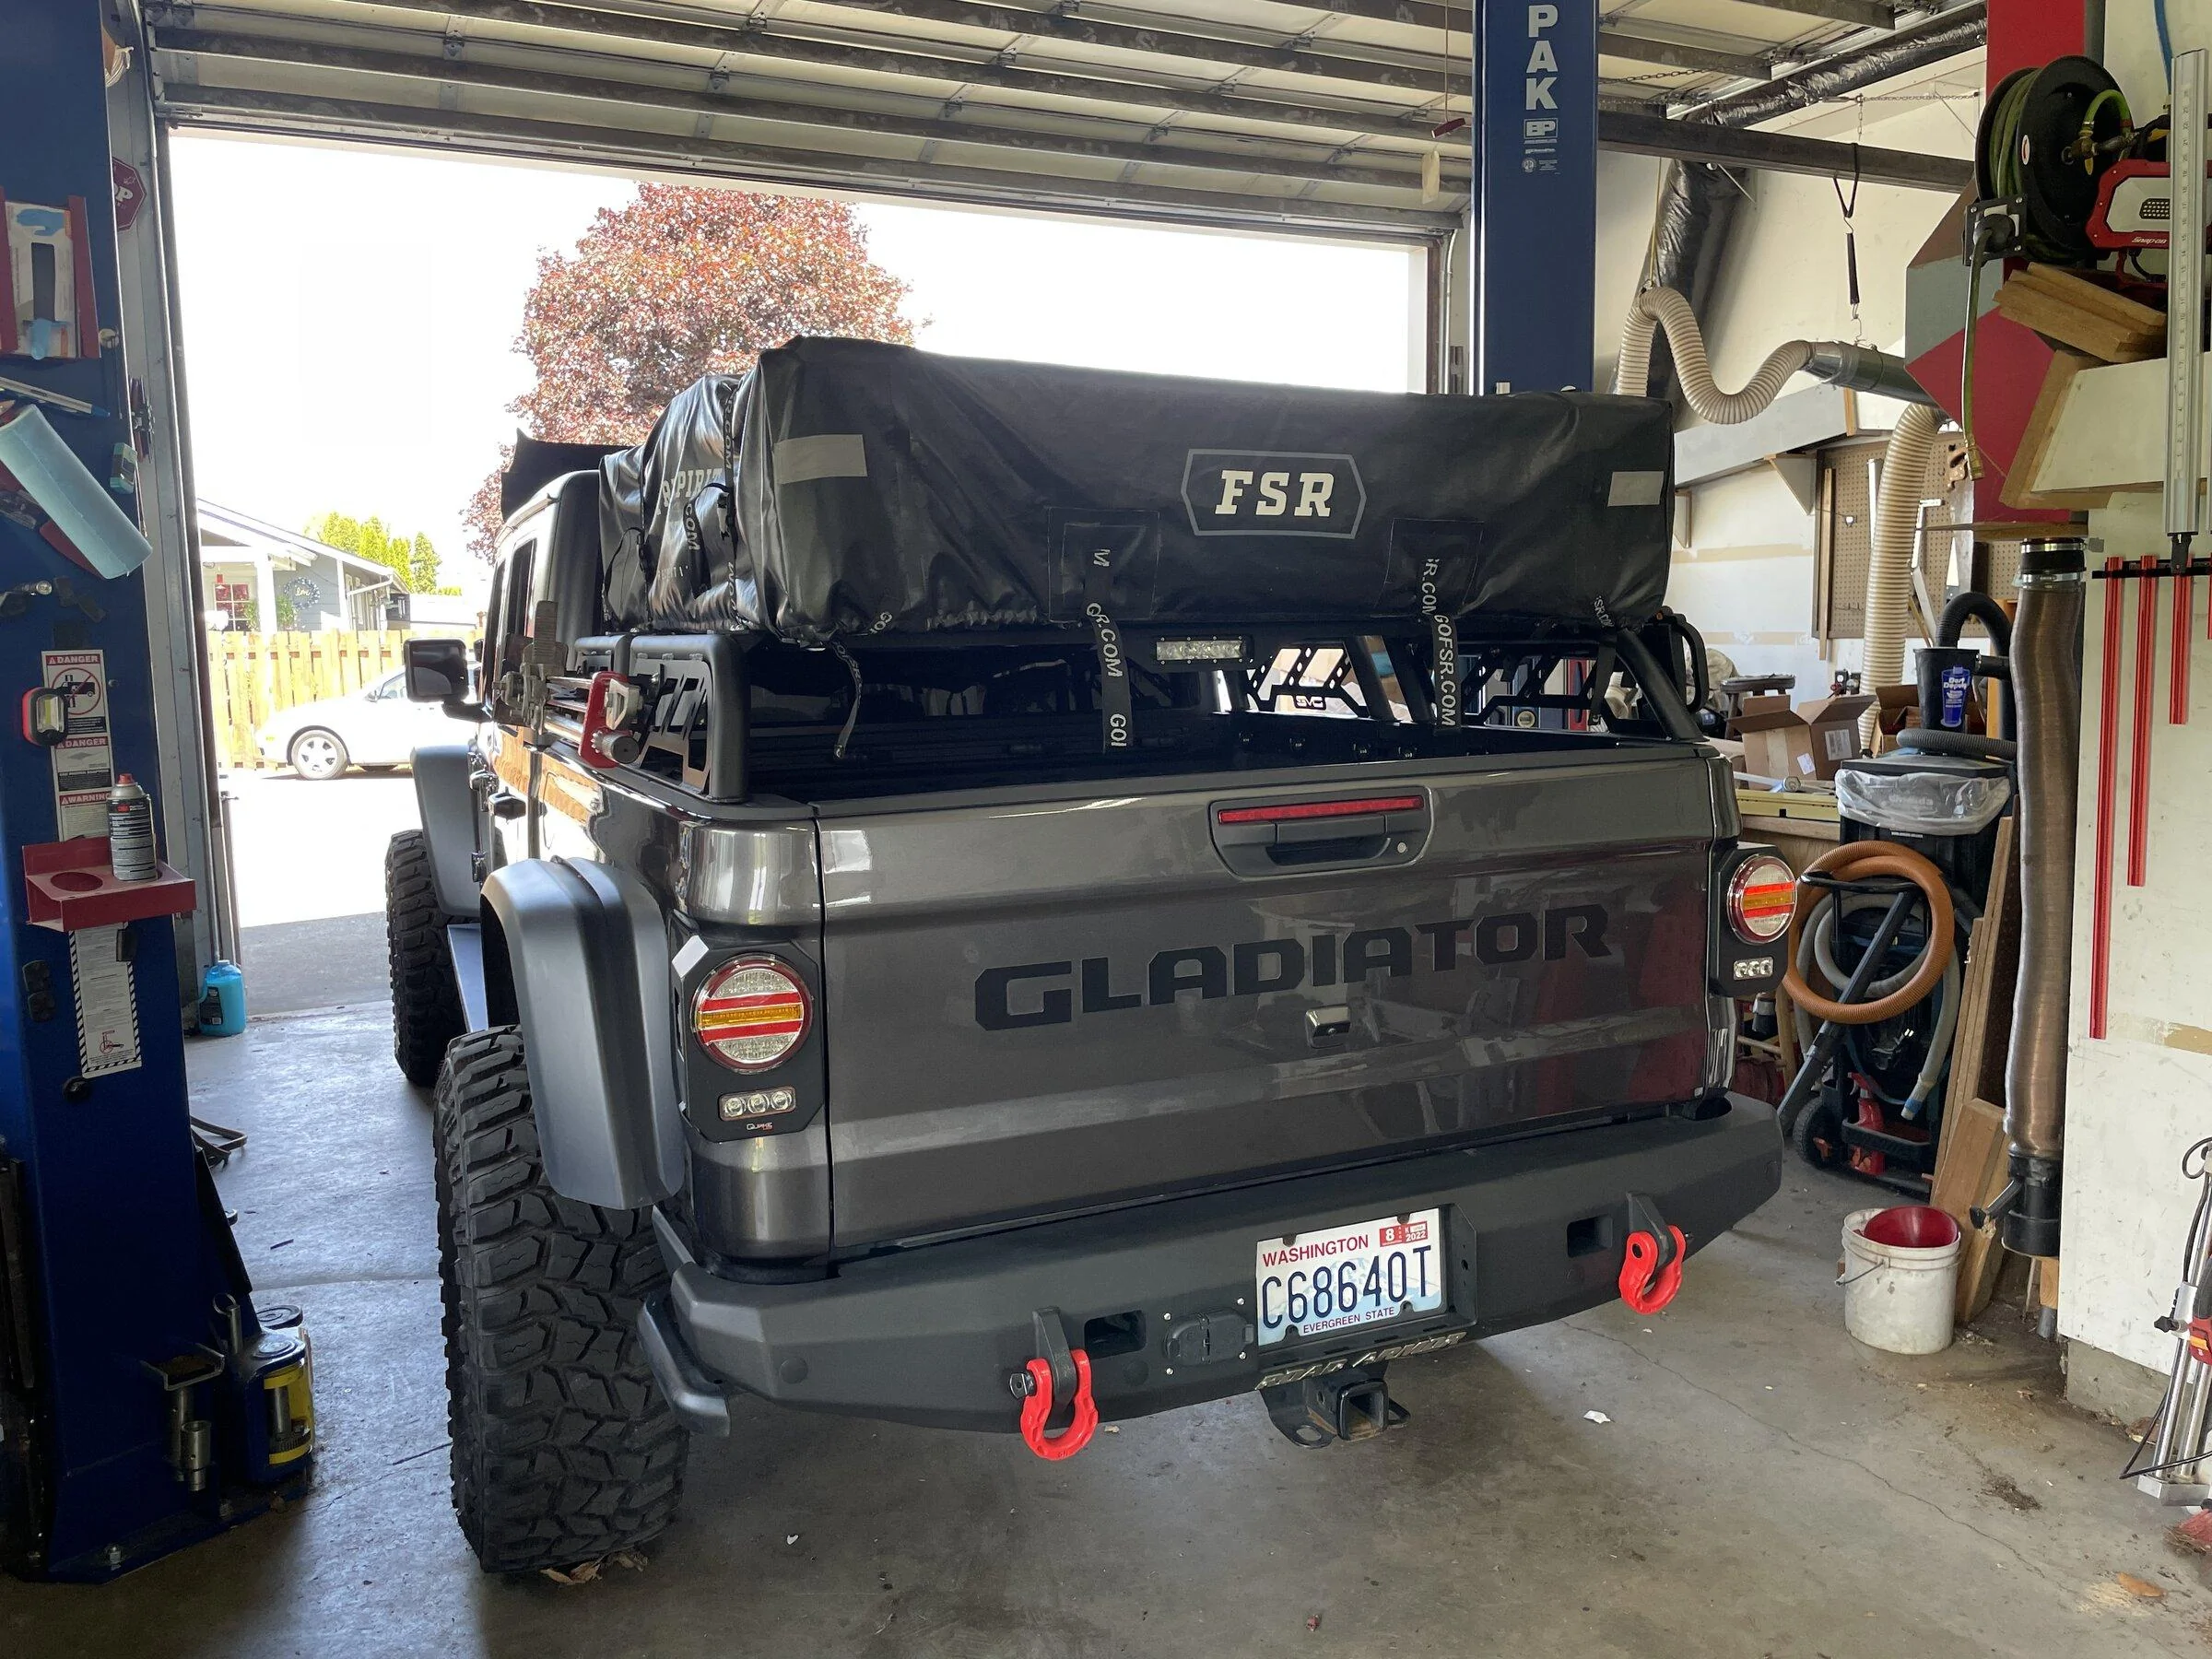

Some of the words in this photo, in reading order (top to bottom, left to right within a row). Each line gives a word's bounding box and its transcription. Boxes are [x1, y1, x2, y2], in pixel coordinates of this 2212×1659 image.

[1525, 4, 1559, 111] PAK
[1215, 470, 1335, 517] FSR
[56, 655, 99, 665] DANGER
[1433, 614, 1457, 726] GOFSR.COM
[64, 738, 106, 747] DANGER
[975, 904, 1613, 1030] GLADIATOR
[1263, 1234, 1369, 1267] WASHINGTON
[1385, 1228, 1395, 1241] 8
[1406, 1230, 1427, 1241] 2022
[1262, 1245, 1431, 1329] C68640T
[1303, 1314, 1360, 1334] EVERGREEN
[1365, 1306, 1394, 1320] STATE
